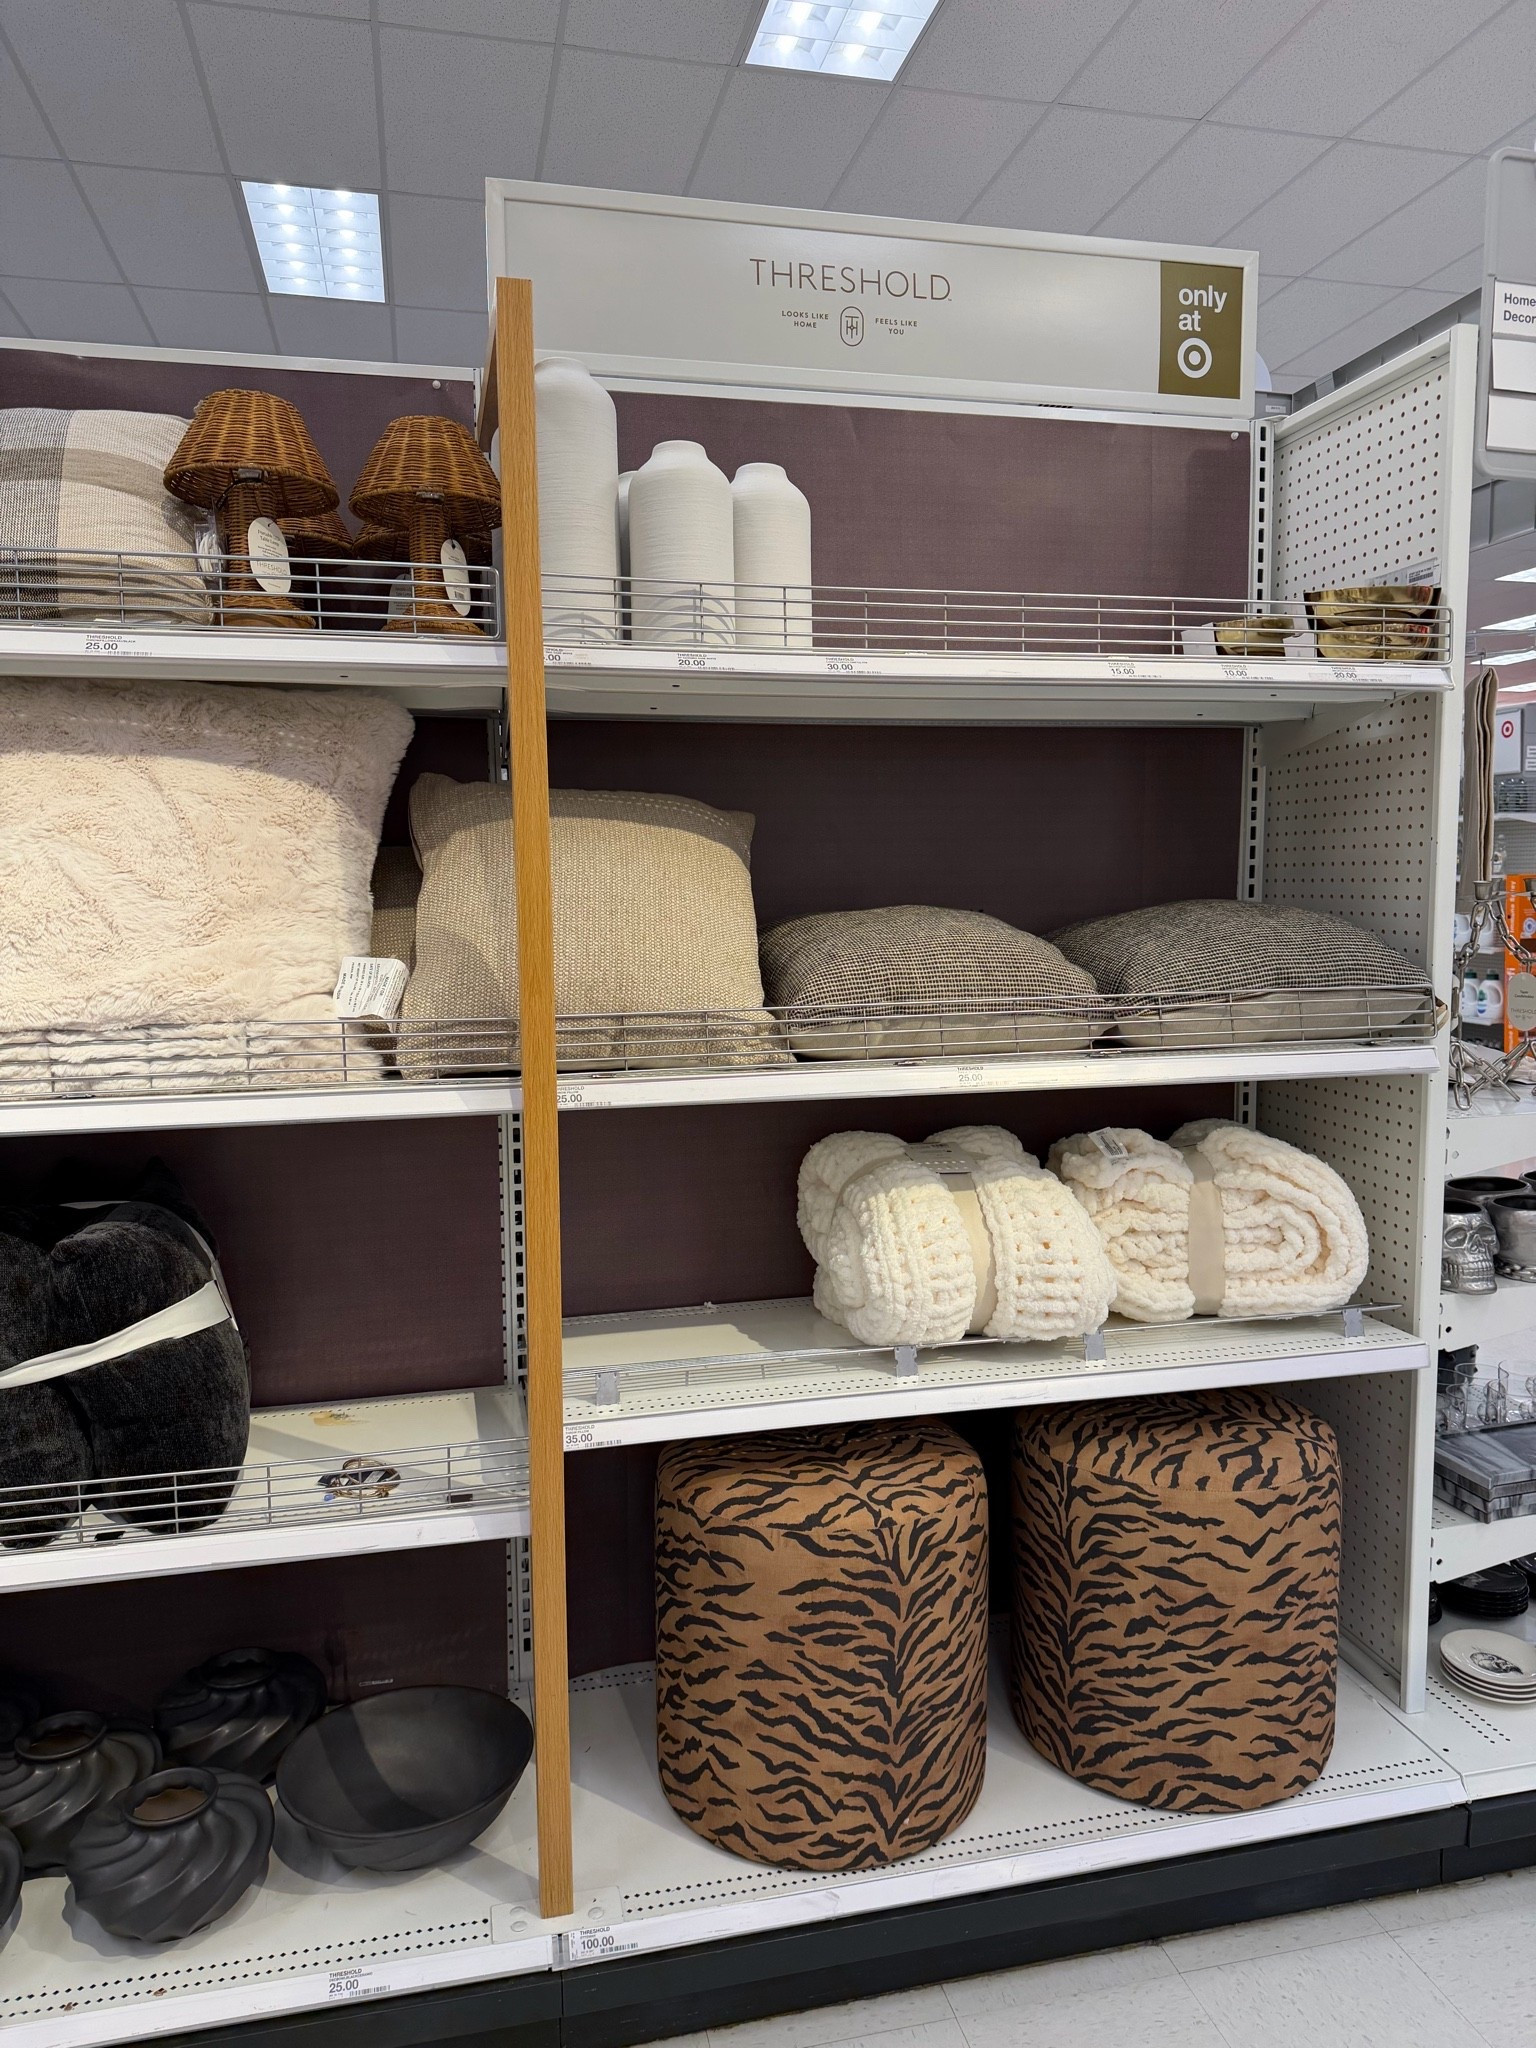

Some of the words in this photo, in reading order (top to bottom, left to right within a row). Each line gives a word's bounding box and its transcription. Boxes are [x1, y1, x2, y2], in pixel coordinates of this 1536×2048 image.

[749, 258, 951, 301] THRESHOLD
[1178, 285, 1228, 313] only
[1504, 292, 1536, 307] Home
[781, 310, 809, 319] LOOKS
[811, 312, 829, 320] LIKE
[1503, 309, 1536, 324] Decor
[793, 320, 817, 329] HOME
[875, 317, 898, 326] FEELS
[900, 319, 918, 327] LIKE
[1178, 310, 1201, 332] at
[888, 327, 904, 335] YOU
[85, 641, 118, 651] 25.00
[678, 659, 706, 667] 20.00
[827, 663, 854, 671] 30.00
[958, 1073, 983, 1082] 25.00
[565, 1433, 593, 1444] 35.00
[579, 1926, 611, 1936] THRESHOLD
[581, 1935, 614, 1950] 100.00
[329, 1968, 363, 1978] THRESHOLD
[329, 1979, 359, 1994] 25.00
